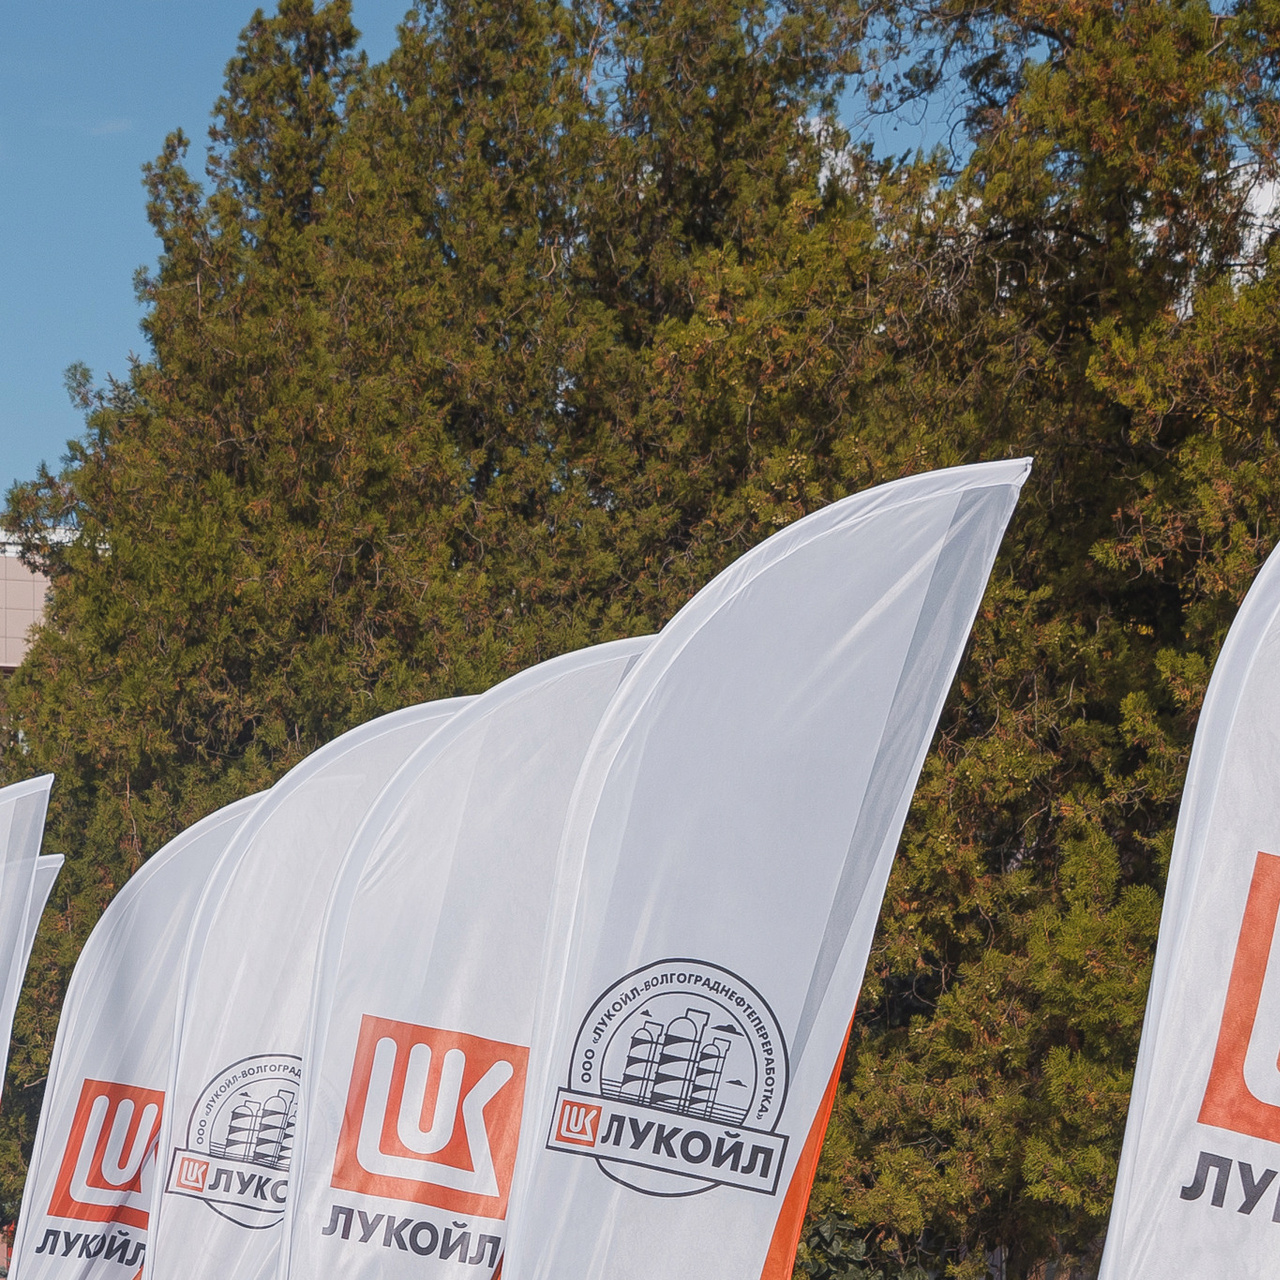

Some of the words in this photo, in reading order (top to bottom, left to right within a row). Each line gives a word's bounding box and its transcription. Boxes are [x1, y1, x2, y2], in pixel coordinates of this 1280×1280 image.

[581, 1048, 595, 1083] ООО
[196, 1119, 207, 1145] ООО
[205, 1064, 302, 1116] «ЛУКОЙЛ-ВОЛГОГРАД
[600, 1113, 775, 1179] ЛУКОЙЛ
[208, 1167, 289, 1204] ЛУКО
[321, 1204, 503, 1269] ЛУКОЙЛ
